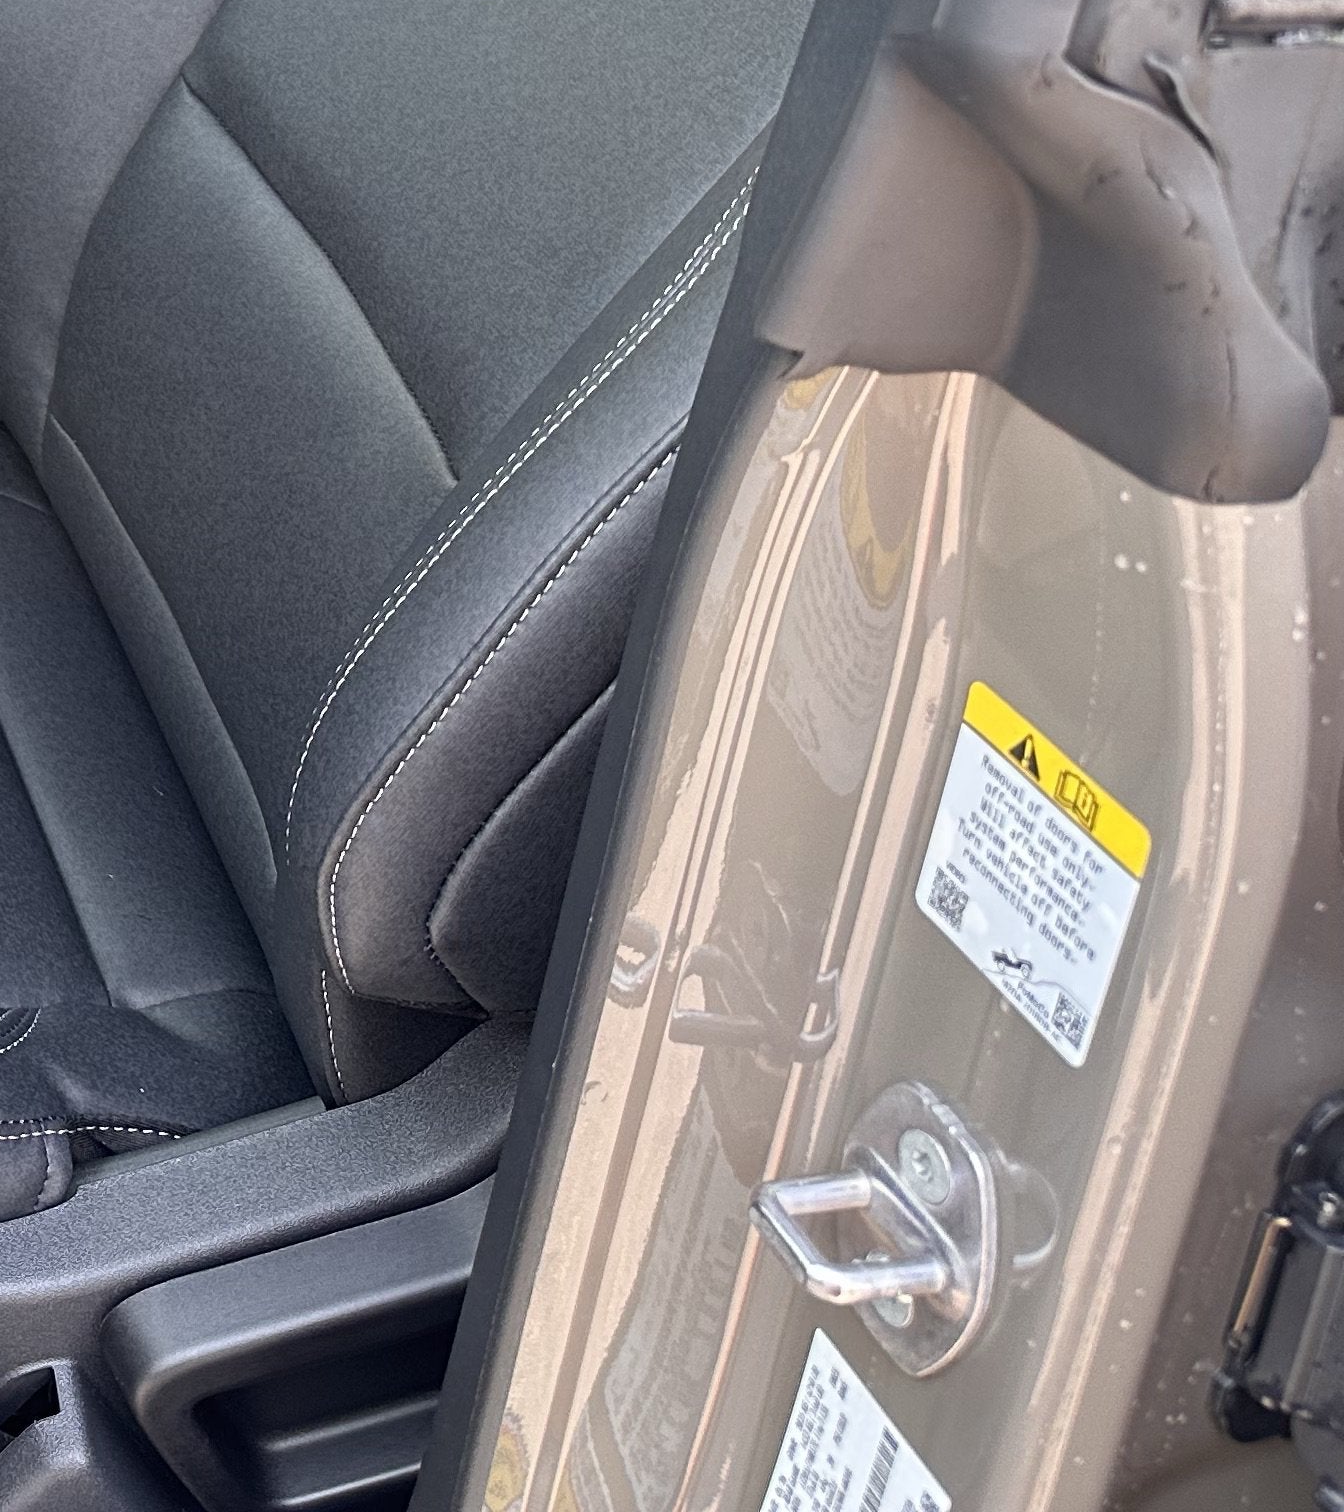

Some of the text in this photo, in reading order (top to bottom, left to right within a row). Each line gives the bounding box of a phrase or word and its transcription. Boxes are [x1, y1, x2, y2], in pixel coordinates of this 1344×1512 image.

[968, 808, 1006, 855] system
[979, 796, 1091, 915] Will affect safety
[980, 753, 1104, 878] Removal of doors for
[983, 778, 1034, 835] off-road
[1037, 830, 1059, 858] use
[956, 816, 1096, 962] Turn vehicle off before
[961, 845, 1035, 926] reconnecting
